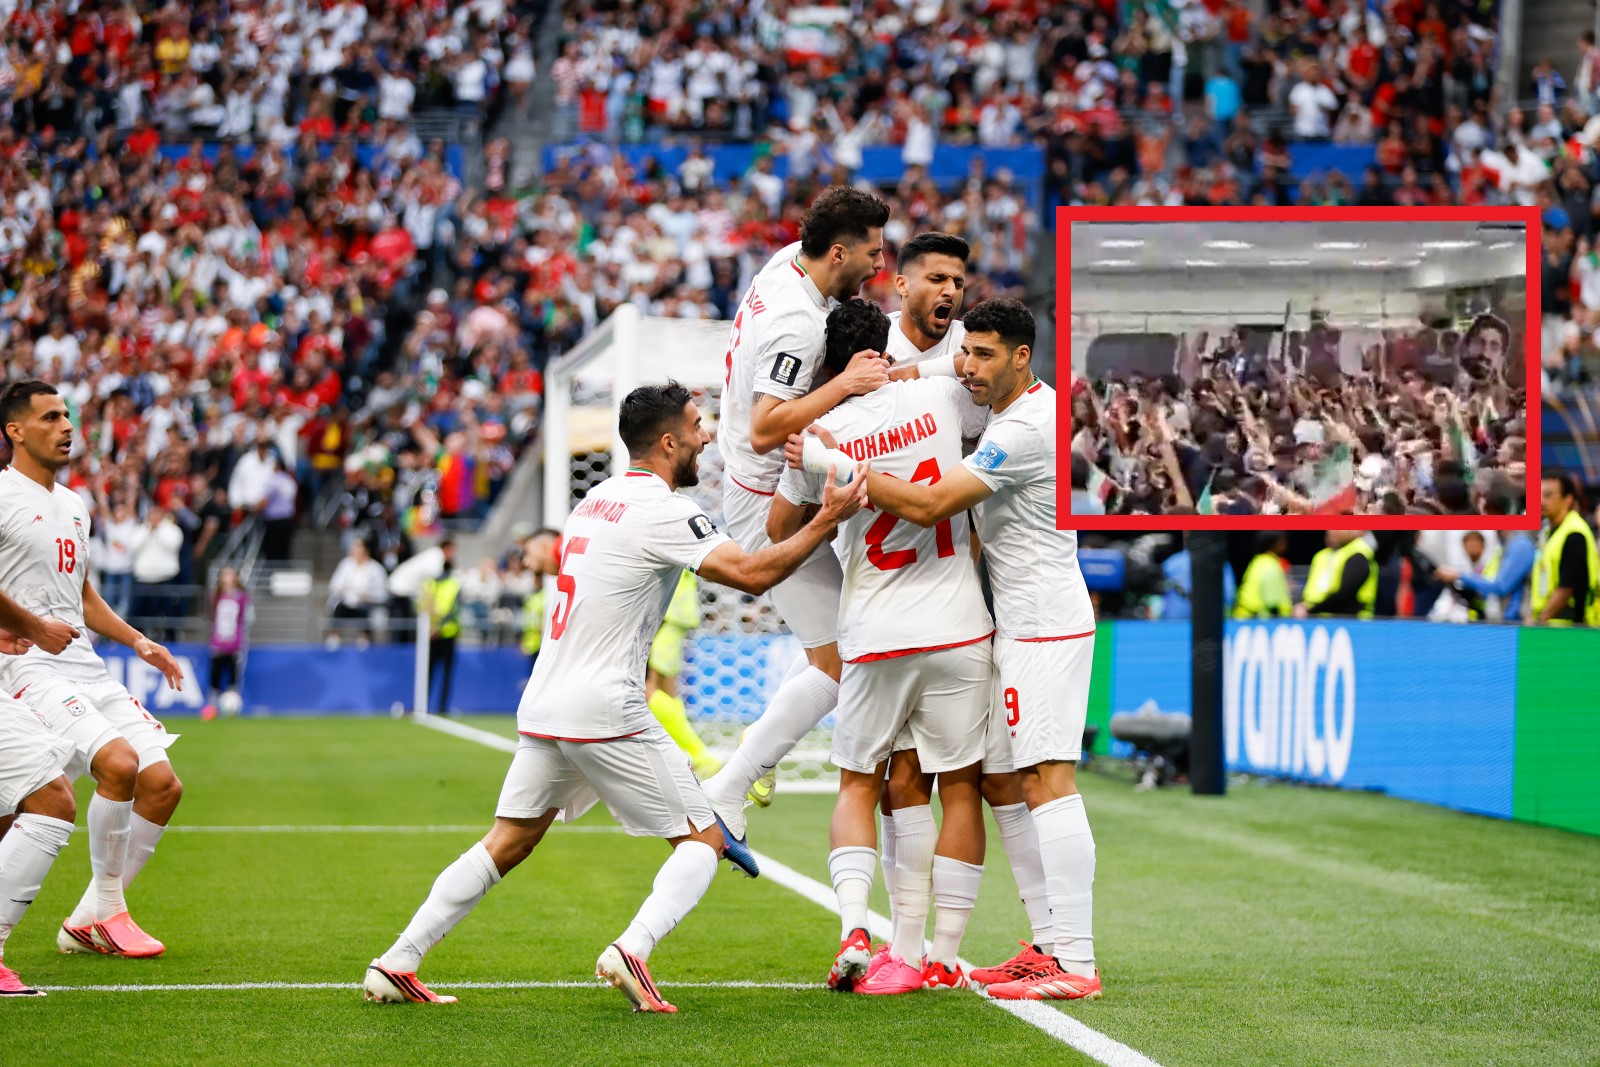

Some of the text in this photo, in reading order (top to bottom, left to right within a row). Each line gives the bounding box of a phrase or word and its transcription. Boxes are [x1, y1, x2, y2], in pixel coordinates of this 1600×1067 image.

[839, 412, 938, 462] MOHAMMAD
[55, 537, 76, 574] 19
[551, 536, 590, 641] 5
[106, 655, 205, 709] IFA
[1004, 687, 1020, 727] 9
[1222, 624, 1356, 782] ramco
